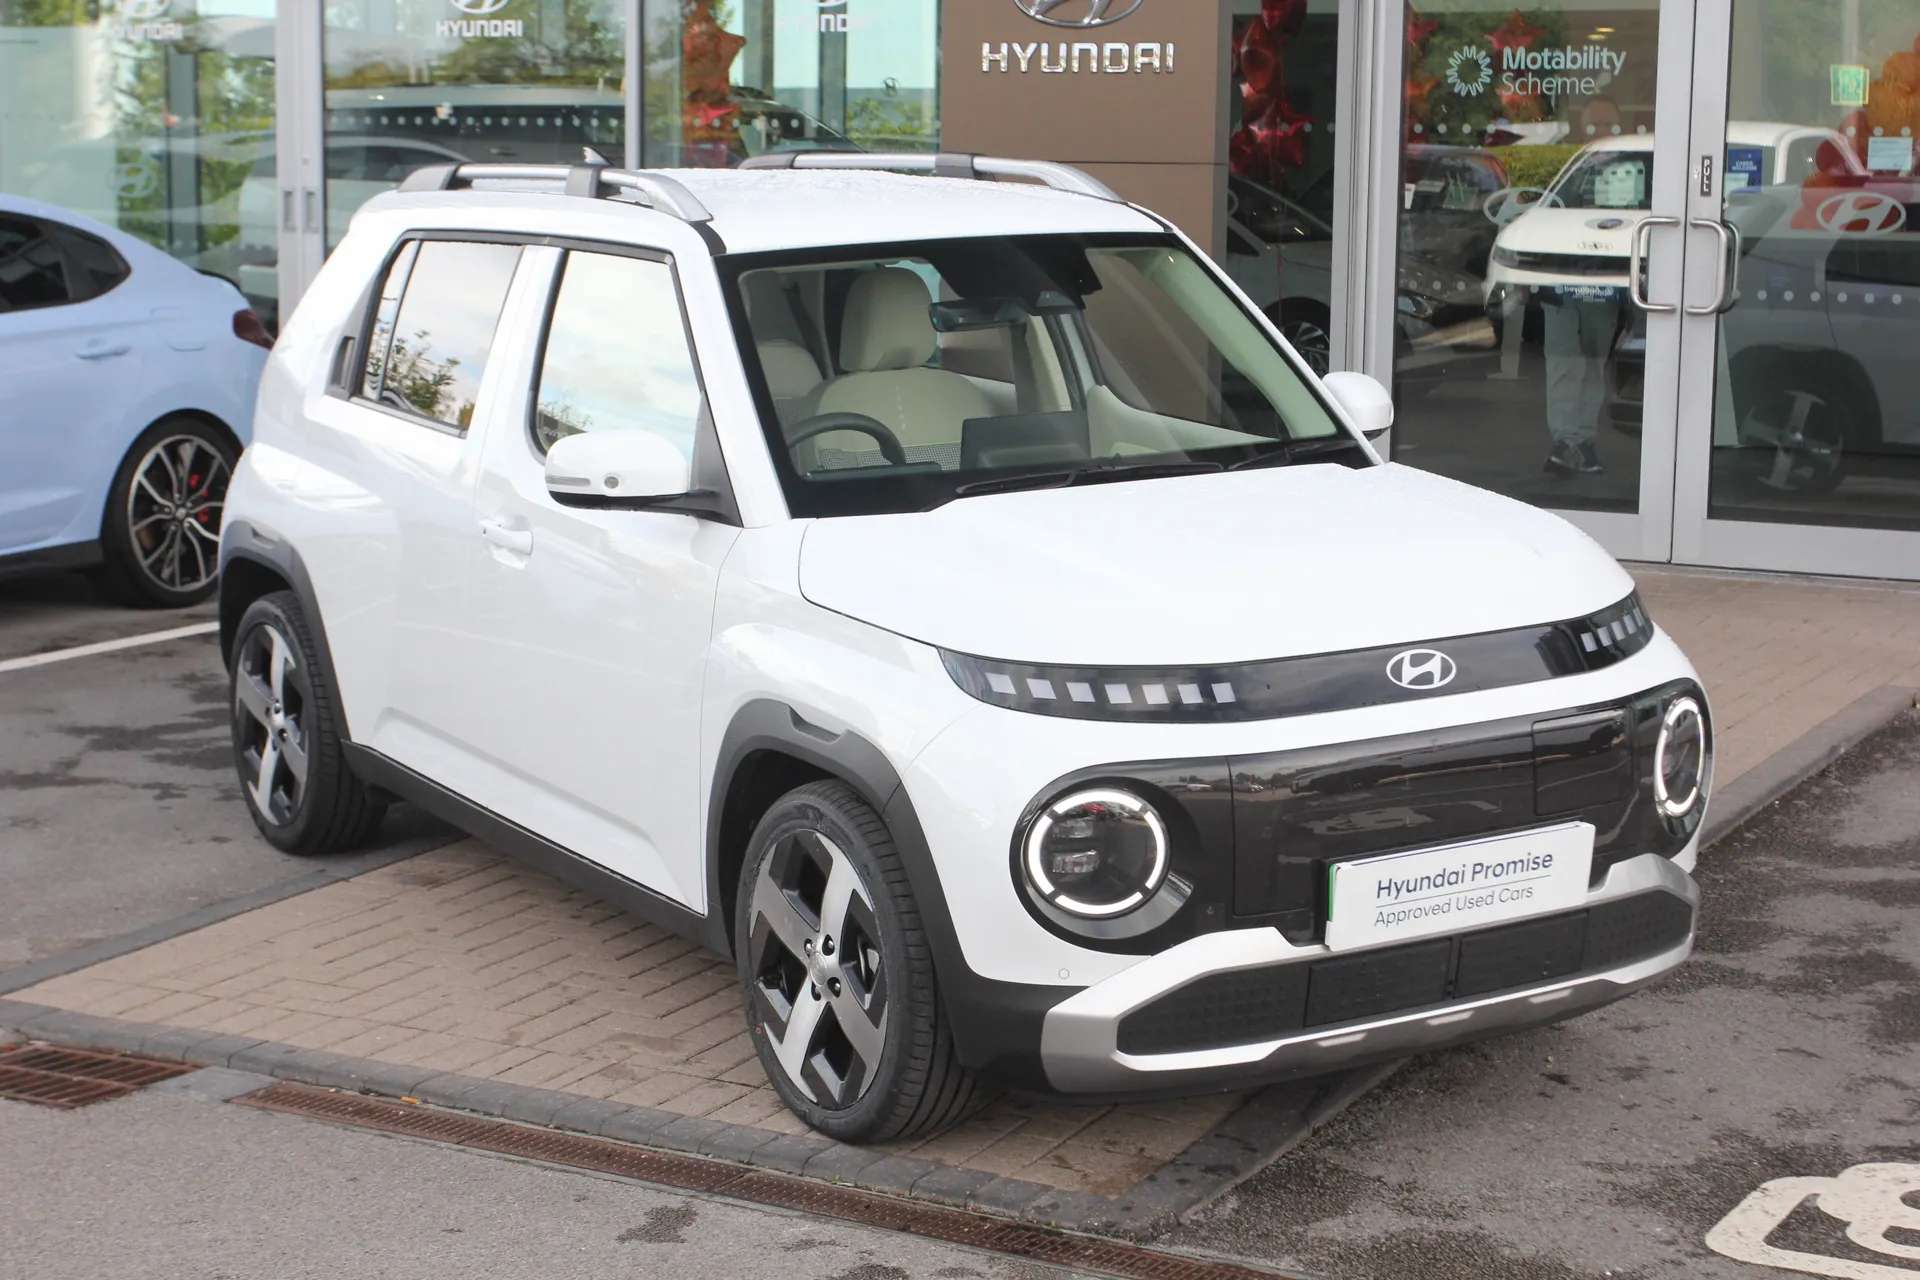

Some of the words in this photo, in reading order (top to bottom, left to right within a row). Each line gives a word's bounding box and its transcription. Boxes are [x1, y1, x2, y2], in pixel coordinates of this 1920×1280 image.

[436, 19, 523, 37] HYUNDAI
[981, 42, 1175, 73] HYUNDAI
[1502, 45, 1626, 75] Motability
[1502, 72, 1596, 95] Scheme
[1703, 158, 1711, 193] PULL
[1376, 865, 1466, 900] Hyundai
[1471, 851, 1553, 883] Promise
[1374, 898, 1452, 927] Approved
[1455, 893, 1495, 912] Used
[1498, 885, 1534, 904] Cars
